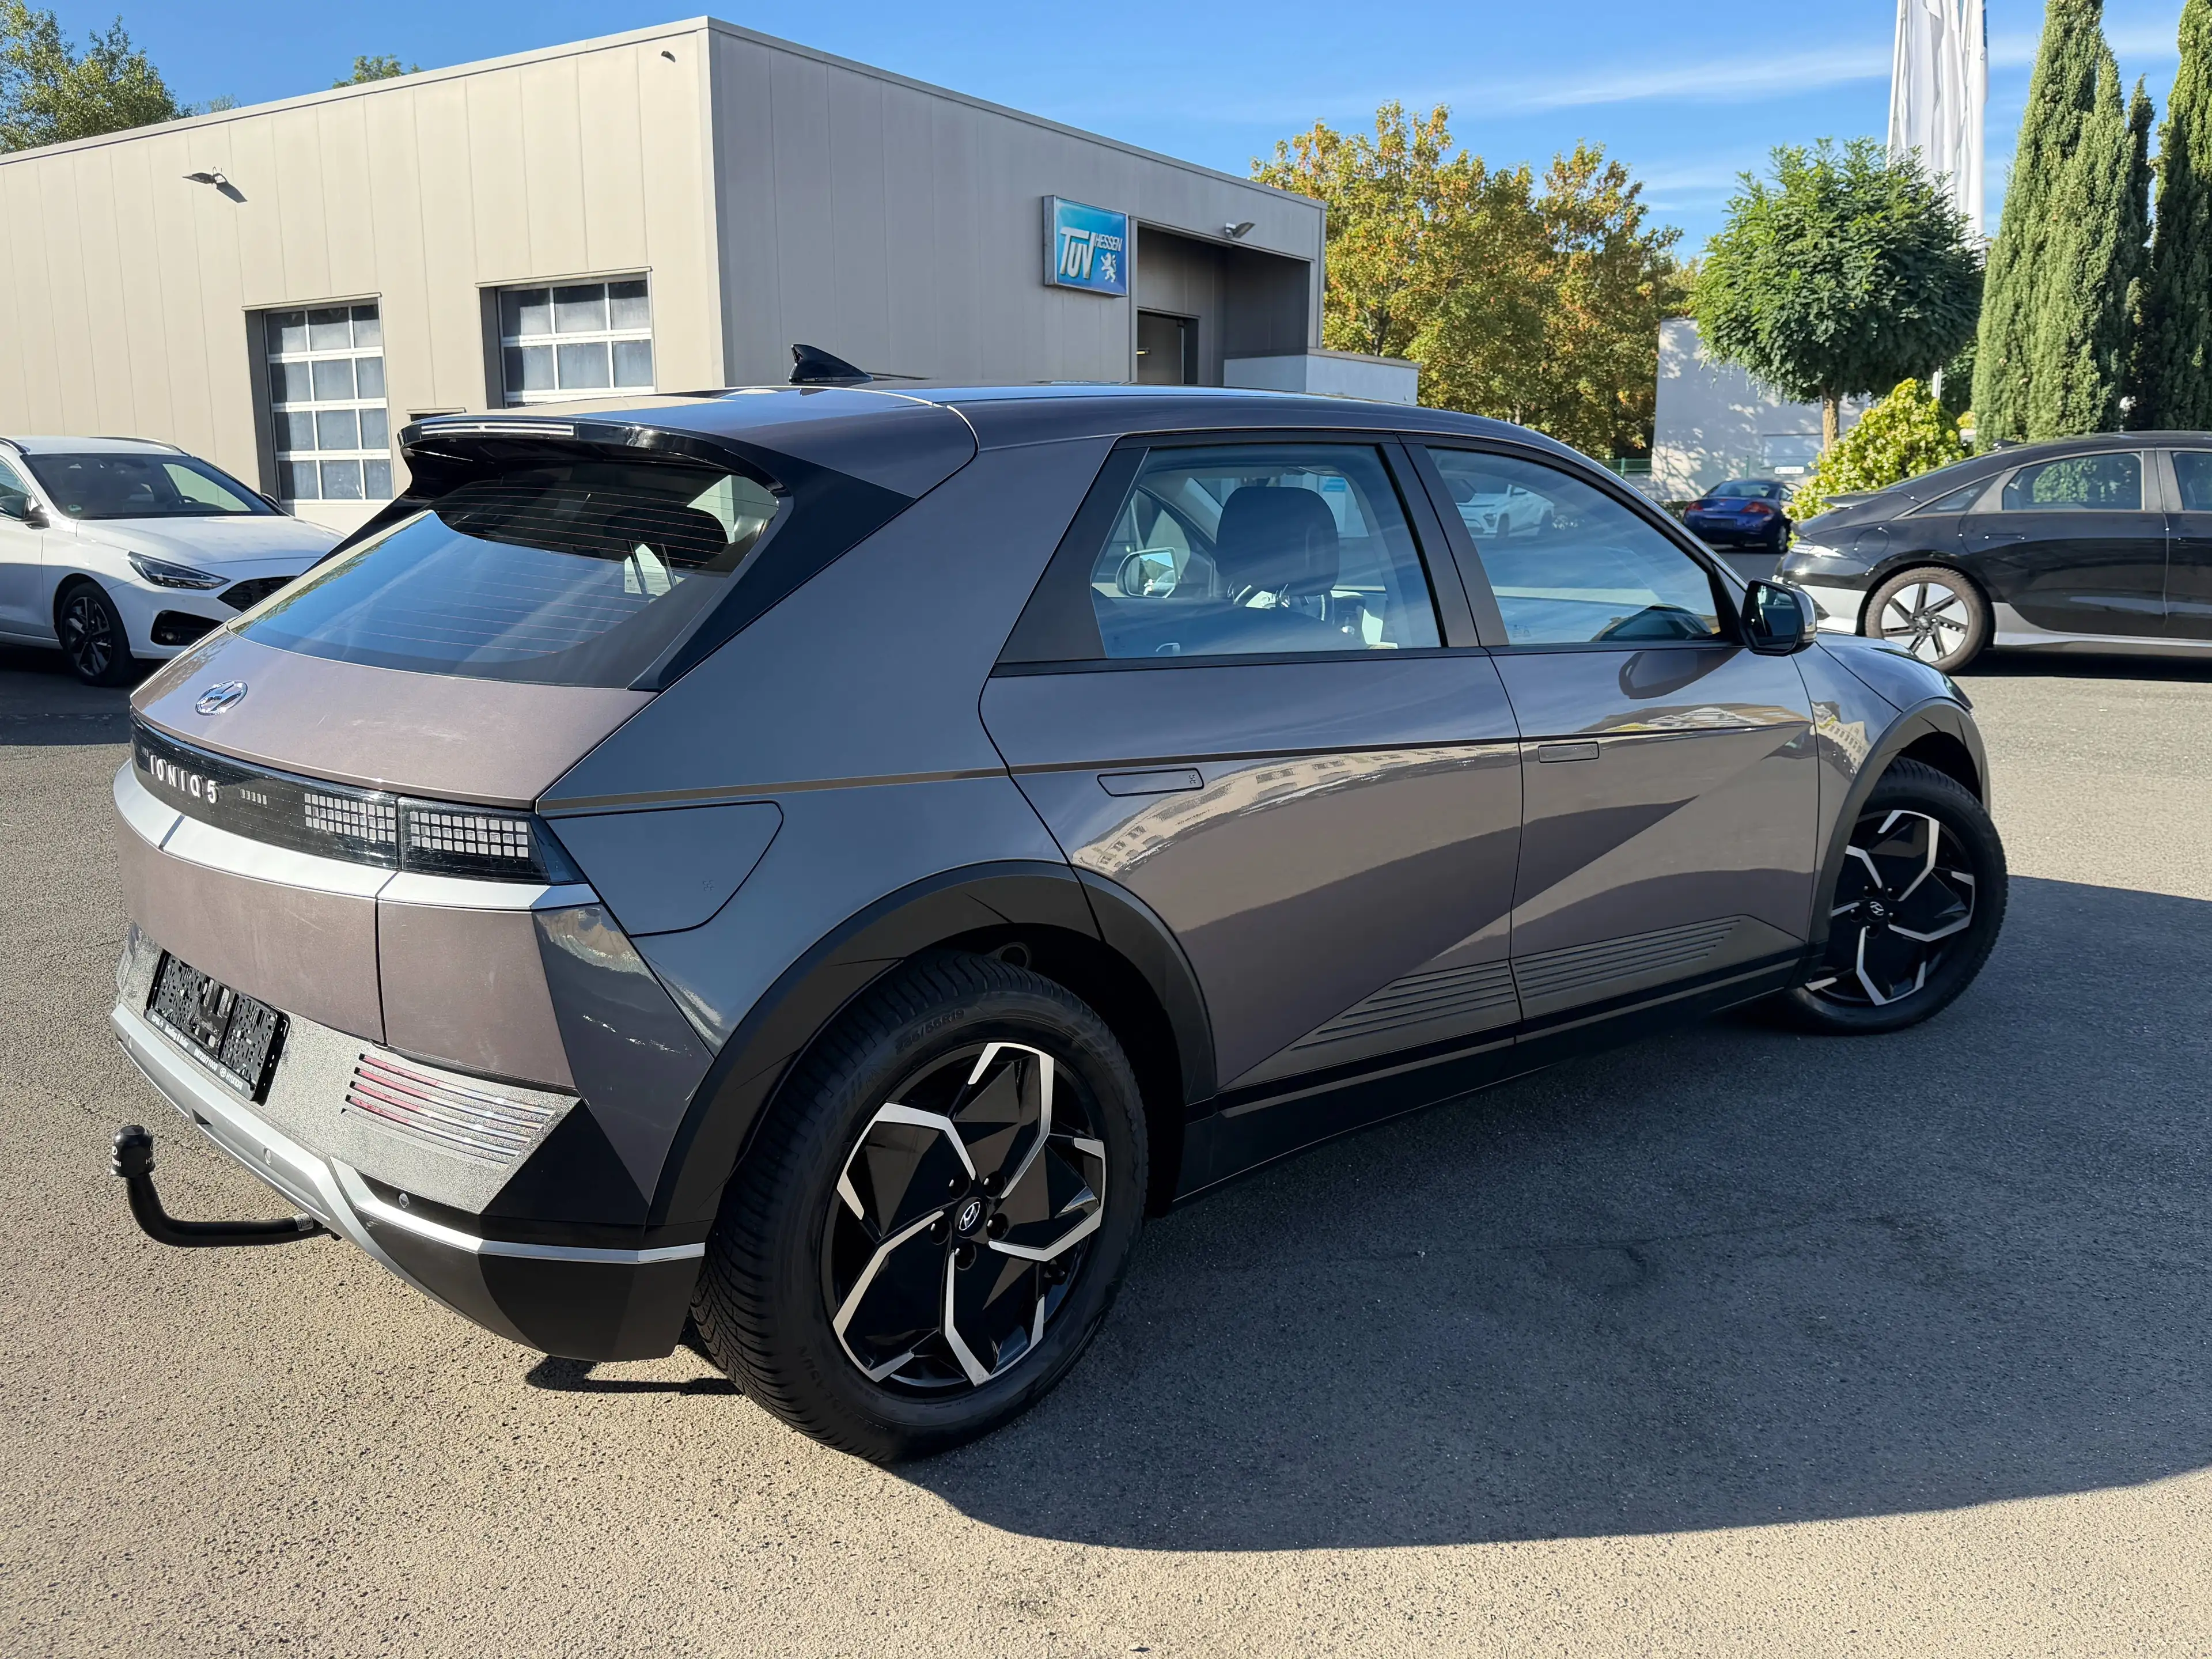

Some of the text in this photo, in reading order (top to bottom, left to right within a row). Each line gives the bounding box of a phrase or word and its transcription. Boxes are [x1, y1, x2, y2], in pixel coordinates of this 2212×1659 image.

[1095, 233, 1123, 252] HESSEN
[150, 755, 219, 804] IONIQ 5
[226, 1071, 243, 1090] HYUNDAI
